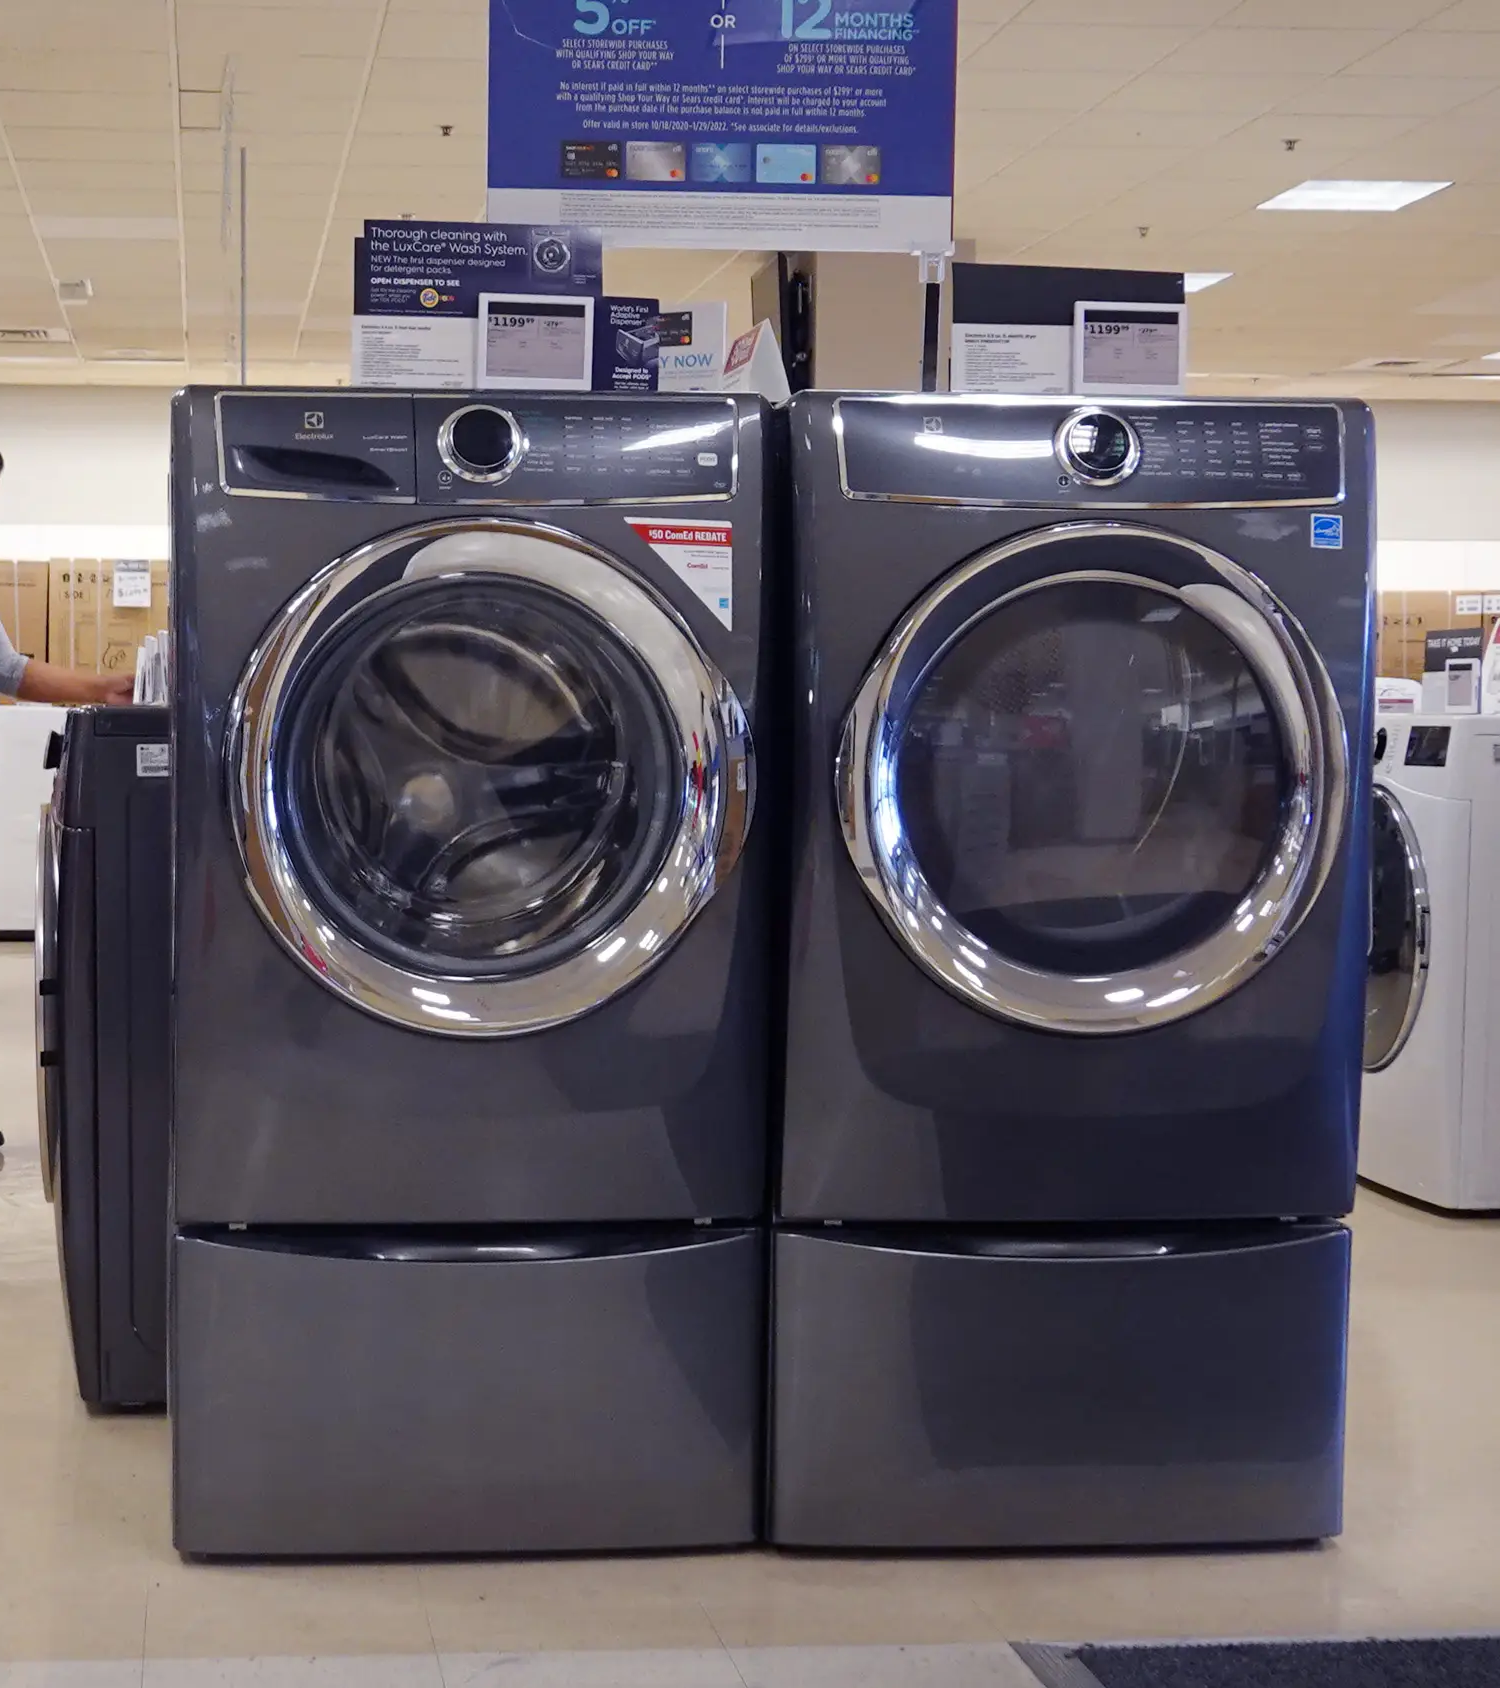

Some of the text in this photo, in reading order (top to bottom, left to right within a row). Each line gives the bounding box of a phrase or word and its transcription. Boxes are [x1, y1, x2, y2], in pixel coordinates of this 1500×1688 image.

[710, 14, 736, 28] OR
[781, 0, 832, 39] 12
[835, 12, 914, 27] MONTHS
[562, 39, 668, 50] SELECT STOREWIDE PURCHASES
[789, 44, 905, 54] ON SELECT STOREWIDE PURCHASES
[556, 49, 674, 60] WITH QUALIFYING SHOP YOUR WAY
[784, 55, 909, 64] OF OR MORE WITH QUALIFYING
[572, 60, 581, 69] OR
[584, 60, 604, 69] SEARS
[607, 61, 630, 70] CREDIT
[777, 64, 795, 73] SHOP
[797, 65, 815, 73] YOUR
[818, 65, 833, 74] WAY
[835, 65, 844, 74] OR
[846, 65, 867, 75] SEARS
[869, 66, 892, 75] CREDIT
[560, 82, 569, 90] No
[572, 82, 598, 90] interest
[608, 83, 624, 92] paid
[626, 83, 632, 91] in
[635, 83, 647, 91] full
[650, 83, 671, 92] within
[674, 83, 679, 91] 12
[729, 85, 748, 94] select
[751, 85, 784, 94] storewide
[787, 87, 822, 96] purchases
[824, 86, 831, 95] of
[865, 88, 883, 96] more
[556, 93, 572, 101] with
[580, 93, 615, 102] qualifying
[618, 93, 635, 102] Shop
[637, 94, 653, 102] Your
[655, 94, 670, 104] Way
[682, 95, 701, 103] Sears
[704, 95, 723, 103] credit
[748, 96, 775, 105] Interest
[777, 96, 789, 105] will
[792, 97, 800, 105] be
[802, 97, 831, 107] charged
[833, 98, 840, 106] to
[842, 99, 858, 107] your
[860, 98, 886, 107] account
[583, 120, 600, 129] Offer
[603, 120, 620, 129] valid
[623, 121, 629, 129] in
[632, 121, 648, 130] store
[749, 123, 780, 132] associate
[783, 124, 793, 132] for
[371, 227, 507, 243] Thorough cleaning with
[371, 241, 389, 250] the
[450, 243, 481, 254] Wash
[484, 244, 528, 257] System.
[371, 255, 505, 268] NEW The first dispenser designed
[384, 265, 424, 274] detergent
[393, 278, 433, 286] DISPENSER
[610, 312, 640, 320] Adaptive
[675, 353, 715, 368] NOW
[649, 529, 727, 542] $50 ComEd REBATE
